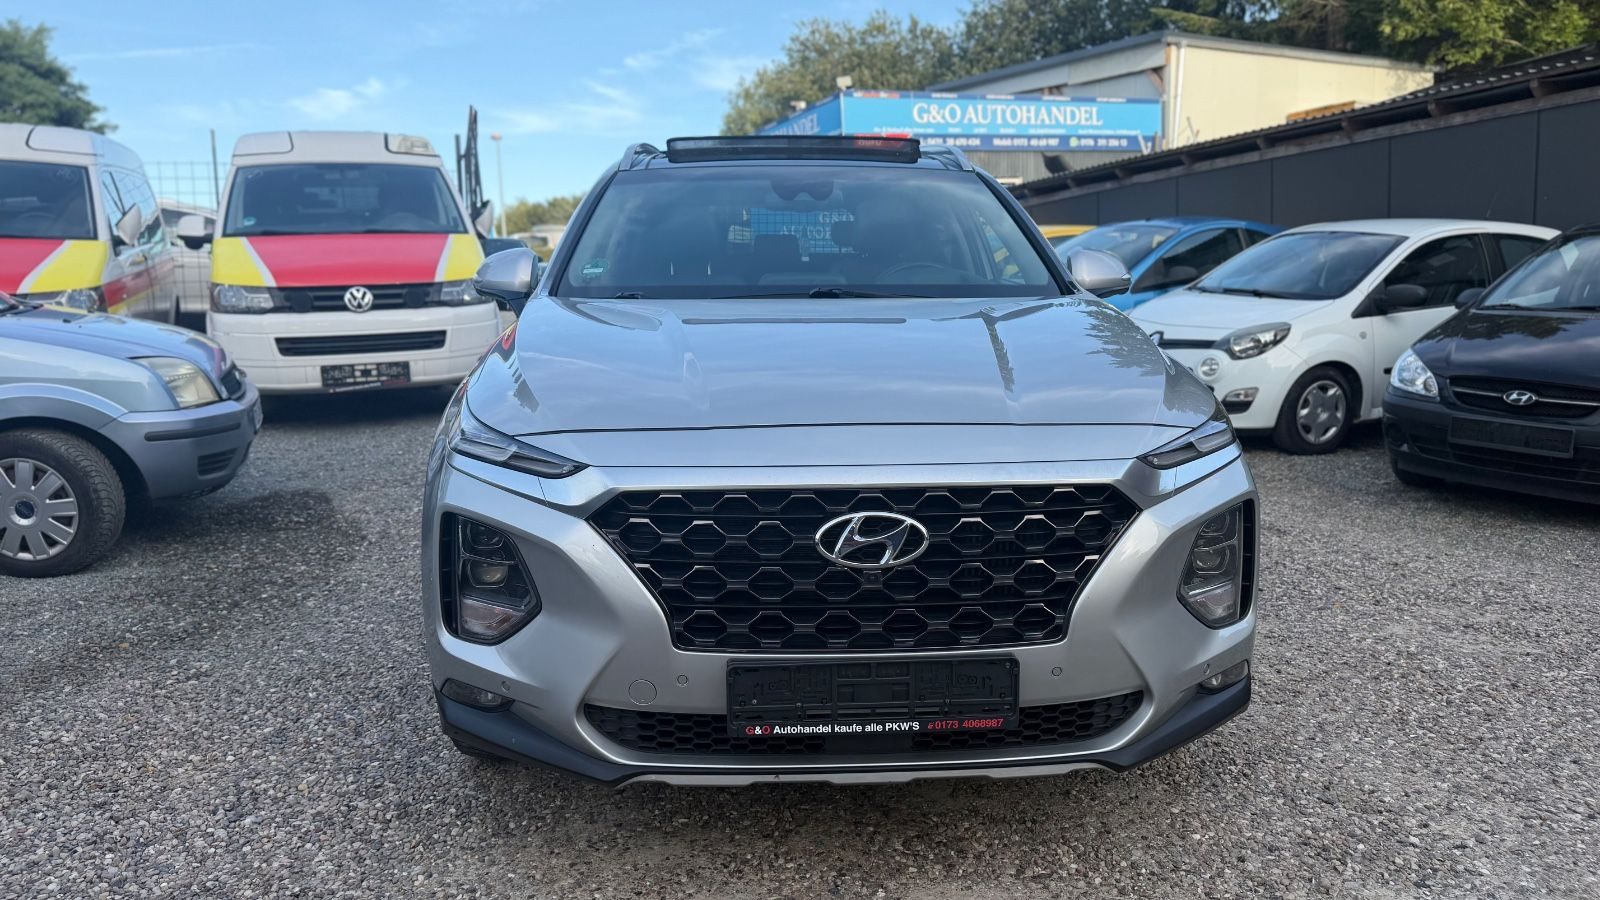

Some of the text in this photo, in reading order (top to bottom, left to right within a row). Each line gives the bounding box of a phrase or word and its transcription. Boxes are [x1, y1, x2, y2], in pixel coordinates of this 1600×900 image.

[912, 103, 1104, 126] G&O AUTOHANDEL
[745, 718, 1004, 735] G&O Autohandel kaufe alle PKW'S 0173 4068987
